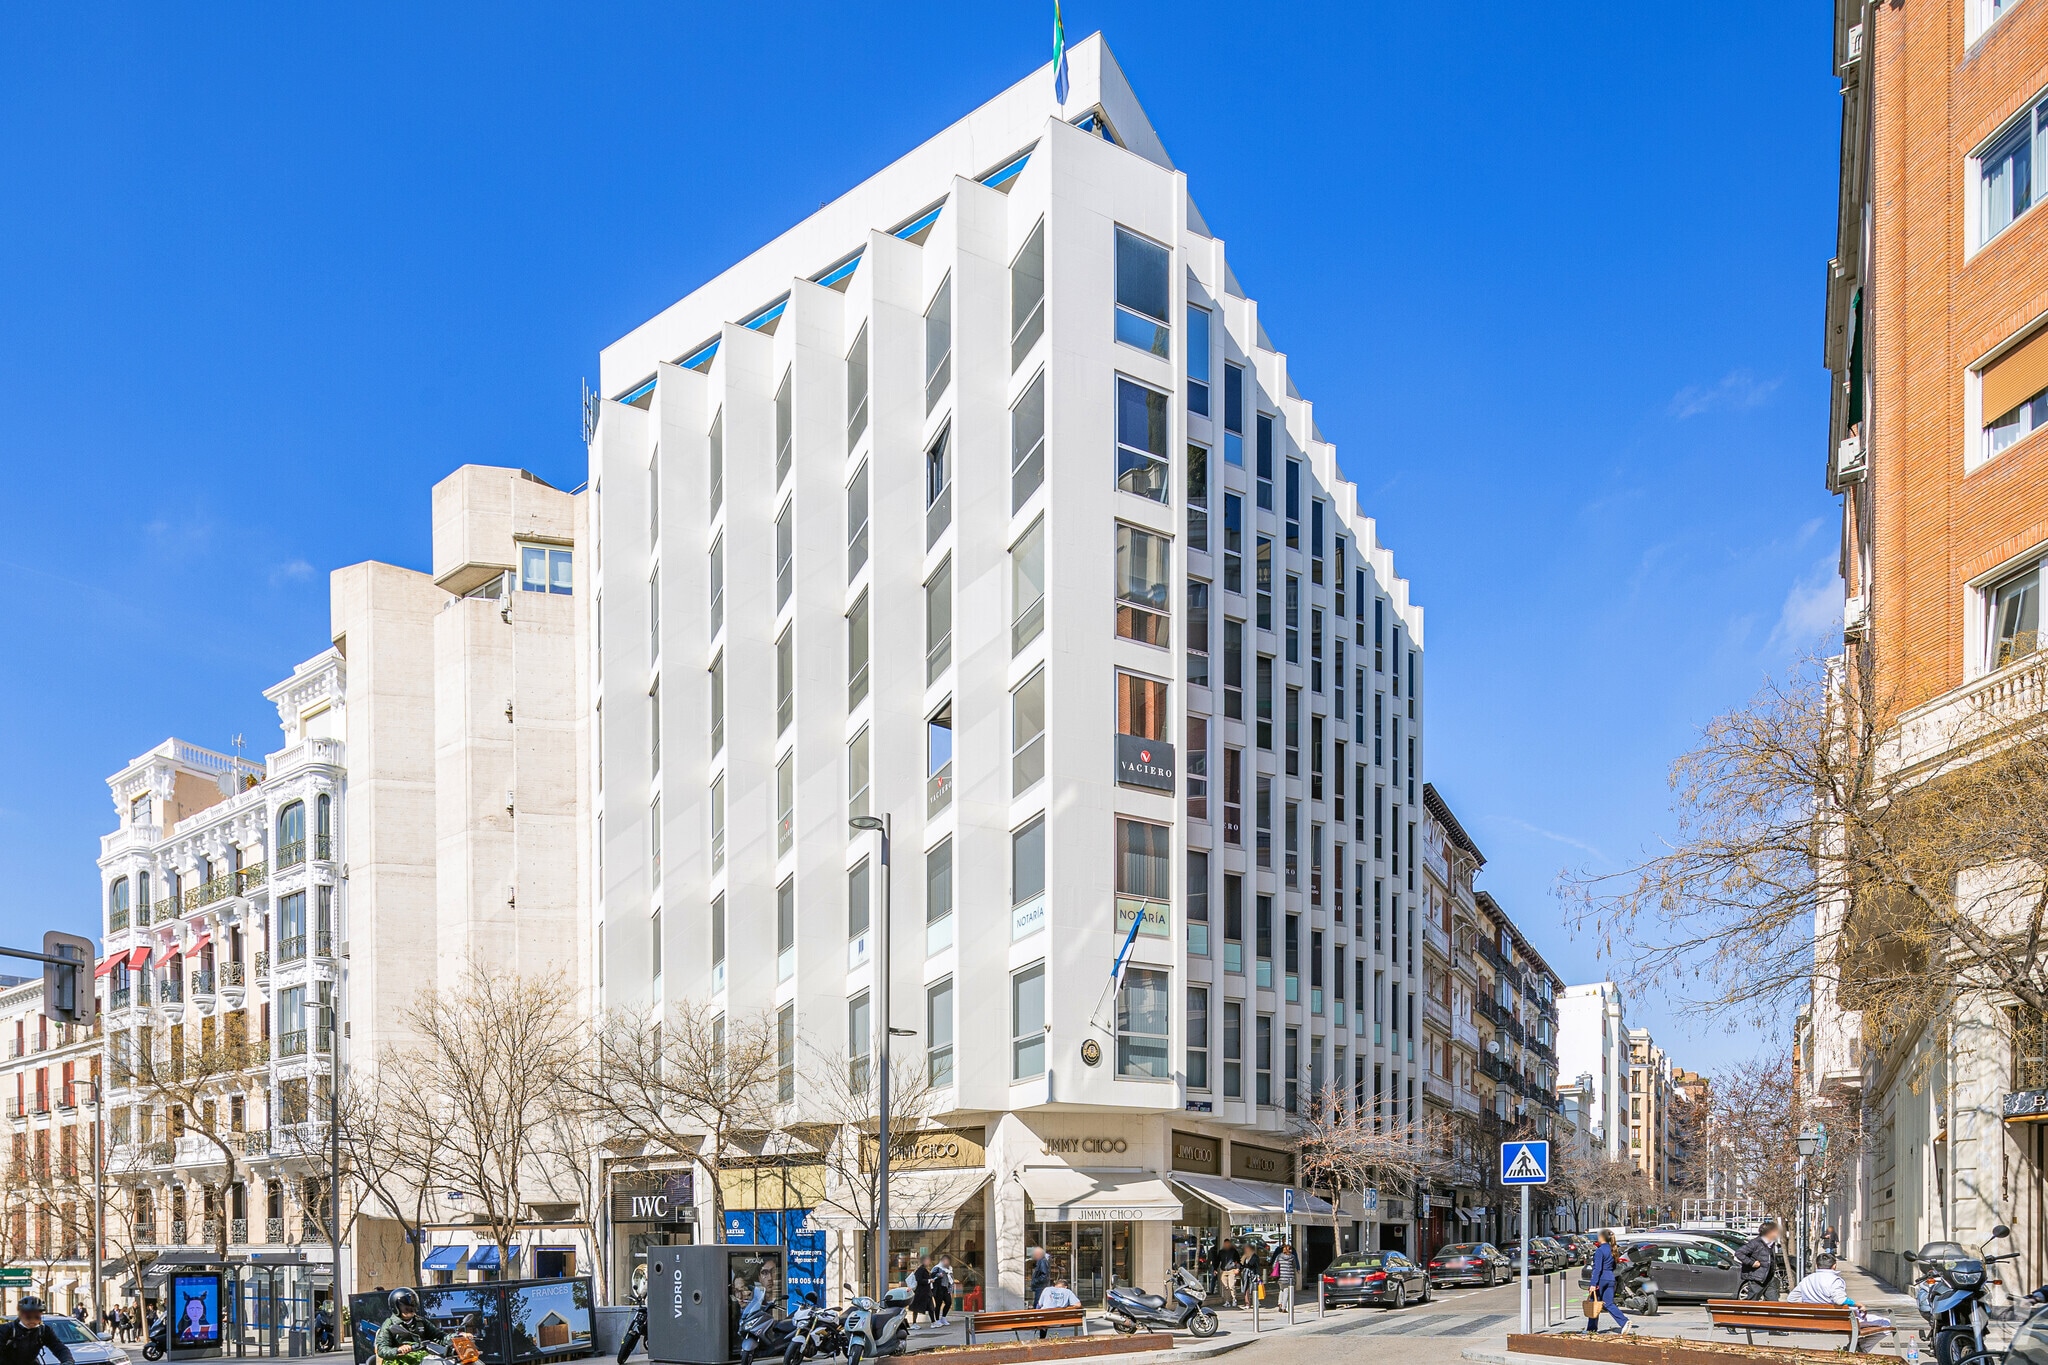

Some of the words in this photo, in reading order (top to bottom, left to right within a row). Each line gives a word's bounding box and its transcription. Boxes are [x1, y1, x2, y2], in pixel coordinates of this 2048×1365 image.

[1121, 761, 1172, 778] VACIERO
[920, 1143, 958, 1159] CHOO
[1040, 1138, 1079, 1156] JIMMY
[1082, 1138, 1127, 1154] CHOO
[1195, 1147, 1212, 1162] CHOO
[631, 1195, 669, 1218] IWC
[1078, 1210, 1107, 1220] JIMMY
[1110, 1209, 1143, 1220] CHOO
[476, 1231, 522, 1241] CHAET
[531, 1285, 569, 1298] FRANCÉS
[674, 1269, 683, 1319] VIDRIO
